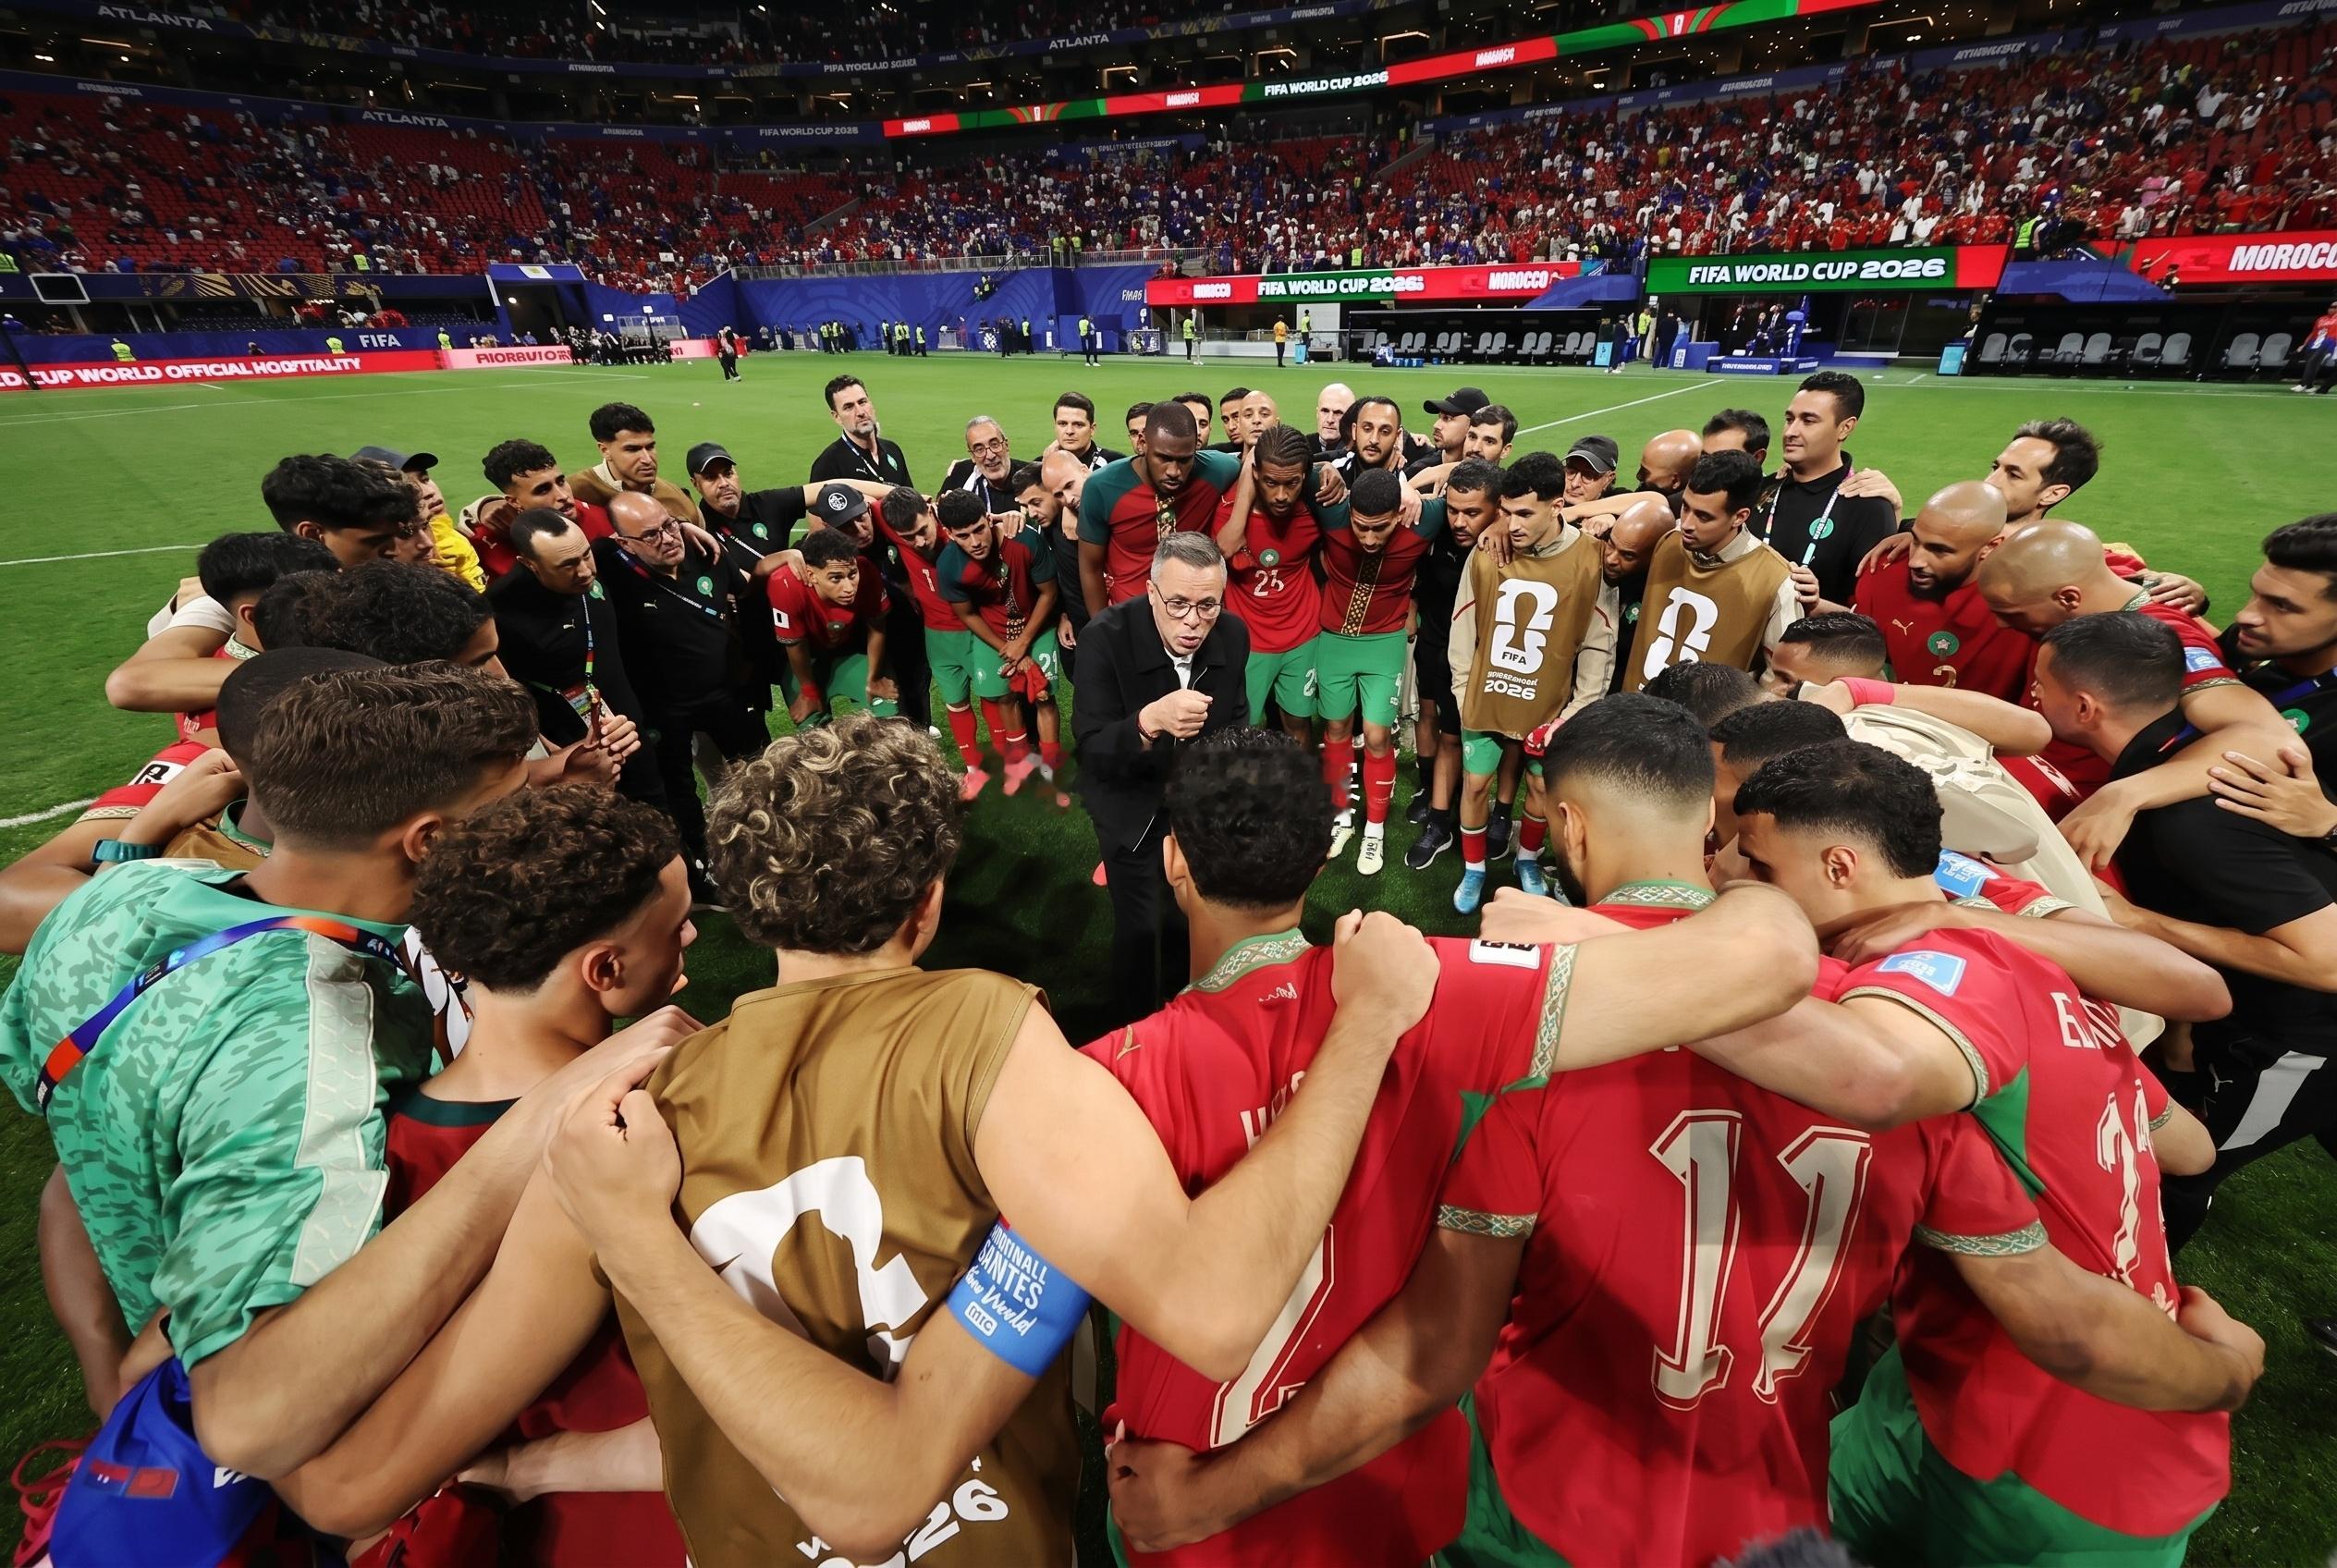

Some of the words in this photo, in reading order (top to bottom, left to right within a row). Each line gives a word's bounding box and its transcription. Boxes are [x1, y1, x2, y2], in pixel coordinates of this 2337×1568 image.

[97, 6, 213, 31] ATLANTA
[1049, 34, 1109, 50] ATLANTA
[1265, 83, 1289, 96] FIFA
[1290, 79, 1328, 93] WORLD
[1329, 77, 1352, 91] CUP
[1352, 70, 1389, 88] 2026
[362, 111, 449, 128] ATLANTA
[759, 128, 779, 136] FIFA
[779, 127, 814, 136] WORLD
[814, 127, 833, 136] CUP
[1487, 270, 1548, 291] MOROCCO
[1689, 265, 1731, 284] FIFA
[1734, 263, 1809, 283] WORLD
[1812, 261, 1858, 280] CUP
[1859, 258, 1946, 279] 2026
[1257, 280, 1287, 296] FIFA
[1289, 278, 1337, 295] WORLD
[1339, 276, 1367, 293] CUP
[359, 334, 401, 348] FIFA
[74, 365, 163, 383] WORLD
[165, 362, 254, 379] OFFICIAL
[1501, 651, 1526, 665] FIFA
[1484, 680, 1536, 700] 2026
[1649, 1109, 1871, 1413] 11
